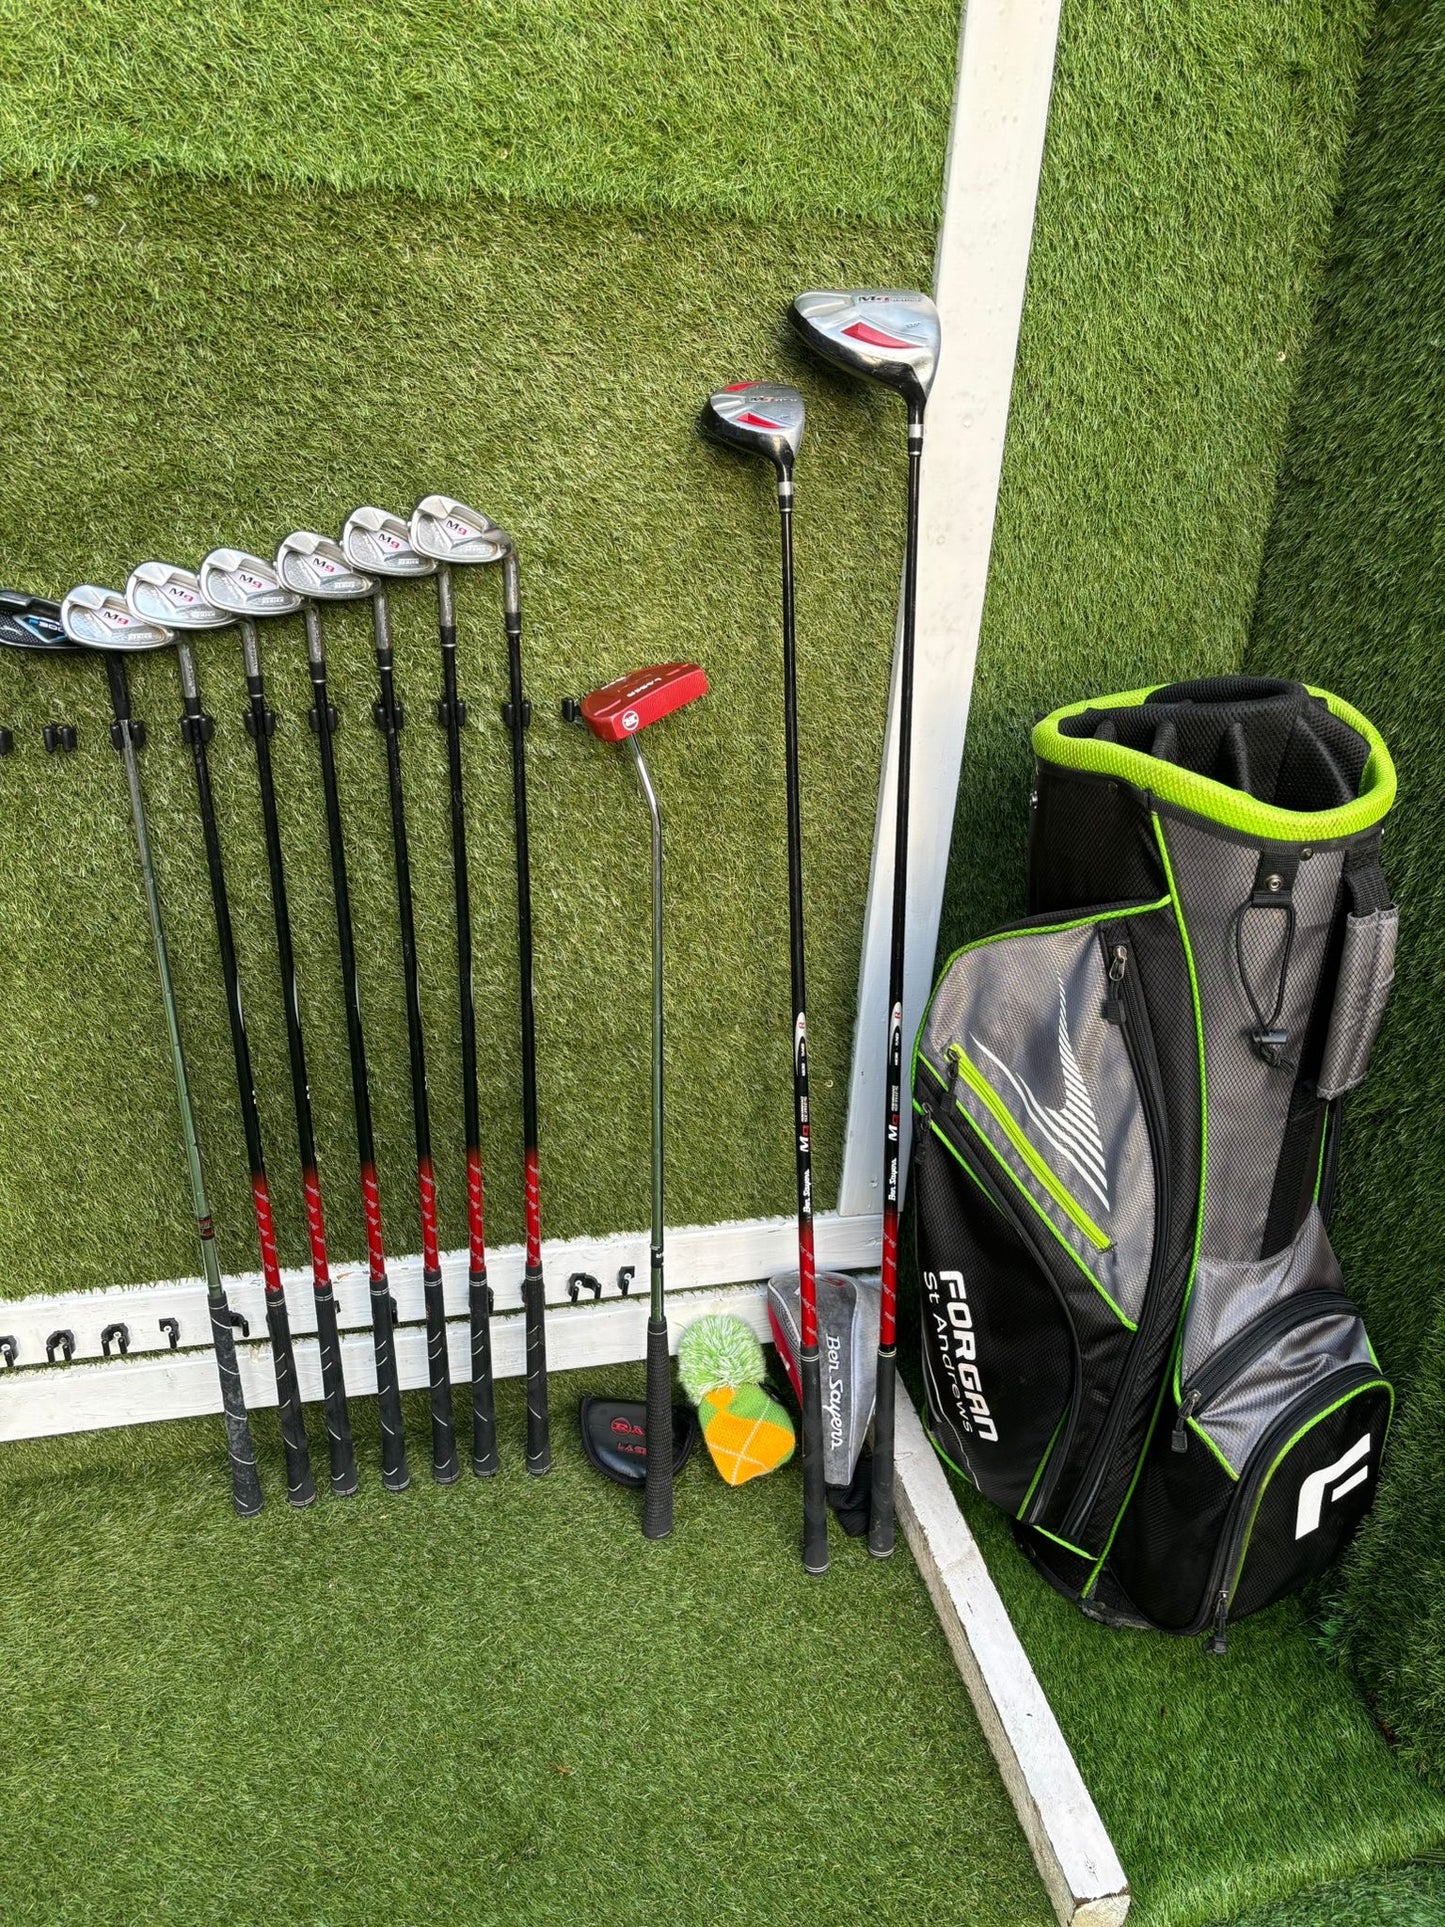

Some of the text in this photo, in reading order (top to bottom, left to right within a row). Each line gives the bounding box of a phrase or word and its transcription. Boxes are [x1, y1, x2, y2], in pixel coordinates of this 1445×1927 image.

[823, 1333, 844, 1451] Ben Sayers
[923, 1270, 973, 1433] St Andrews
[939, 1270, 999, 1442] FORGAN
